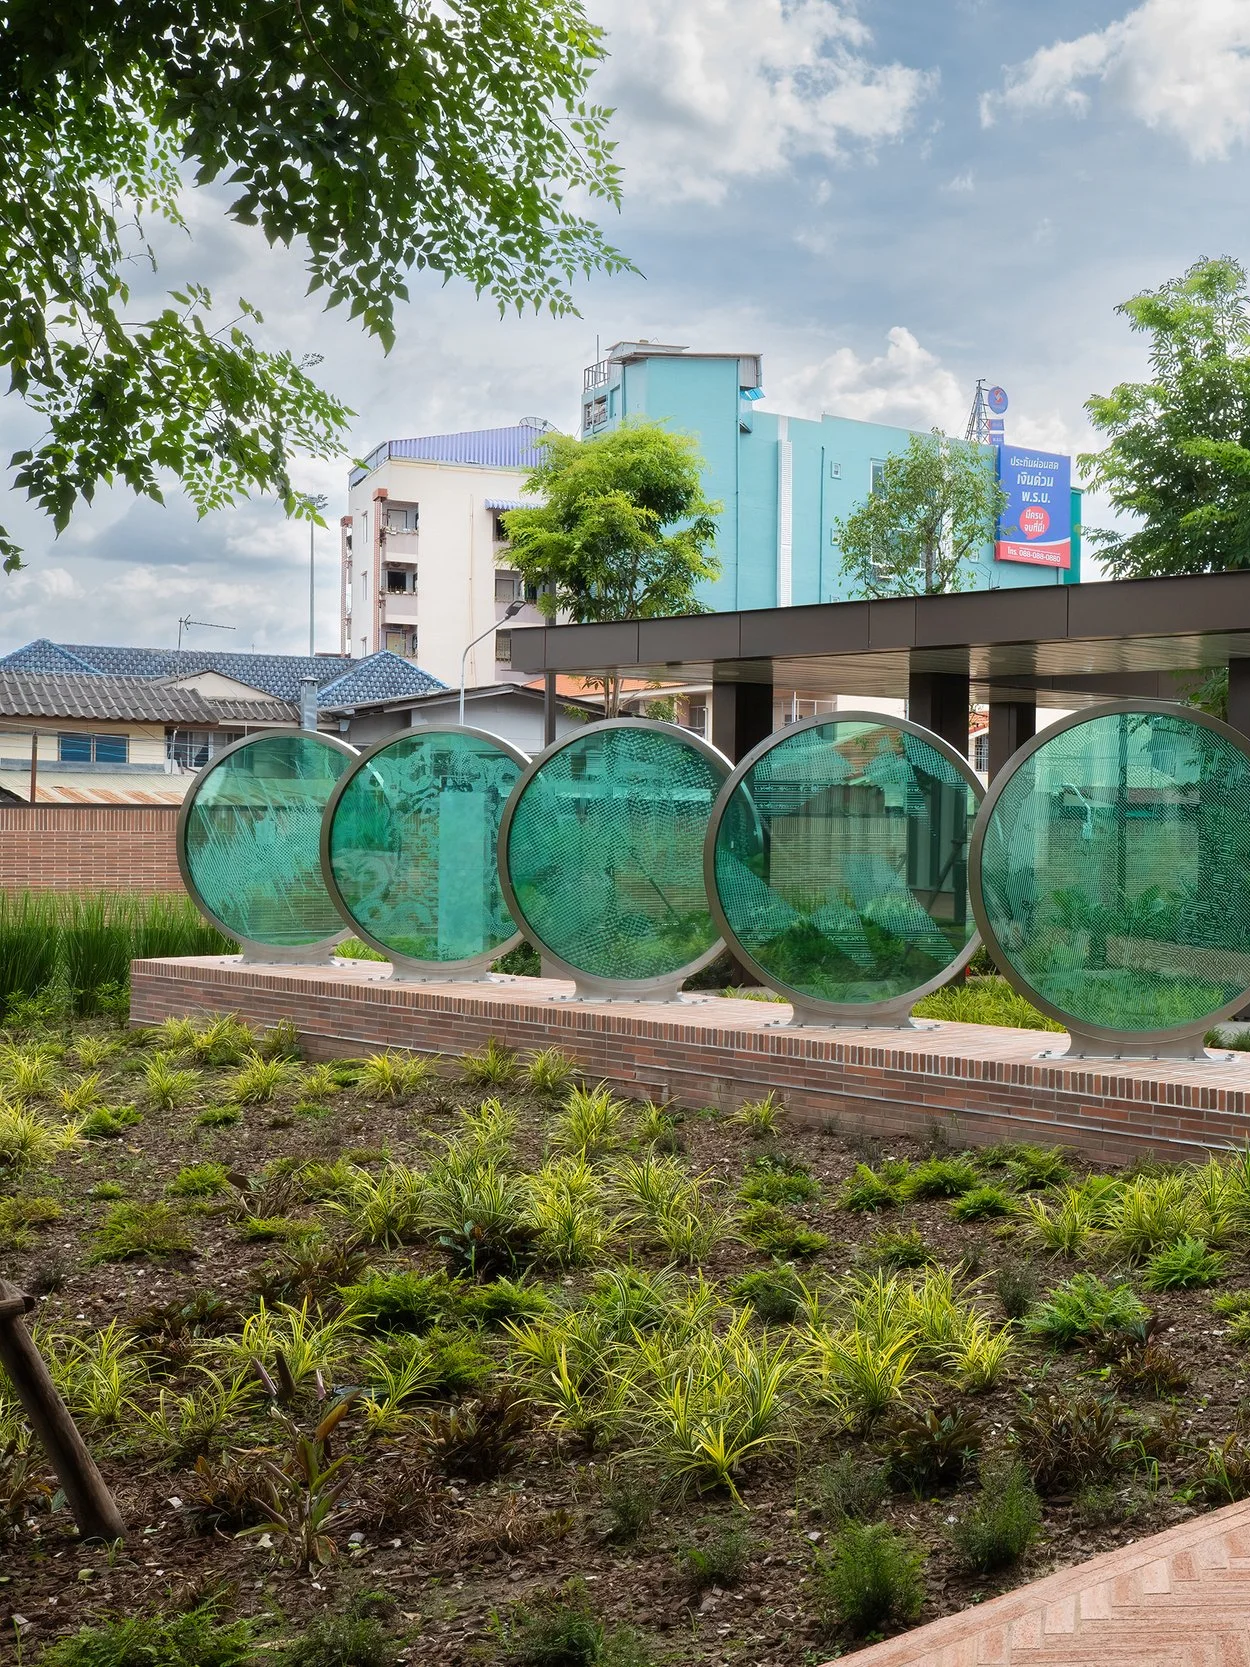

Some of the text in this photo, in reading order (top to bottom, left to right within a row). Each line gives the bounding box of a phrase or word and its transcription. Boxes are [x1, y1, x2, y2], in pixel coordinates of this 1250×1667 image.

[1017, 471, 1054, 487] เงินด่วน
[1021, 491, 1051, 503] พ.ร.บ.
[1025, 509, 1044, 519] มีครบ
